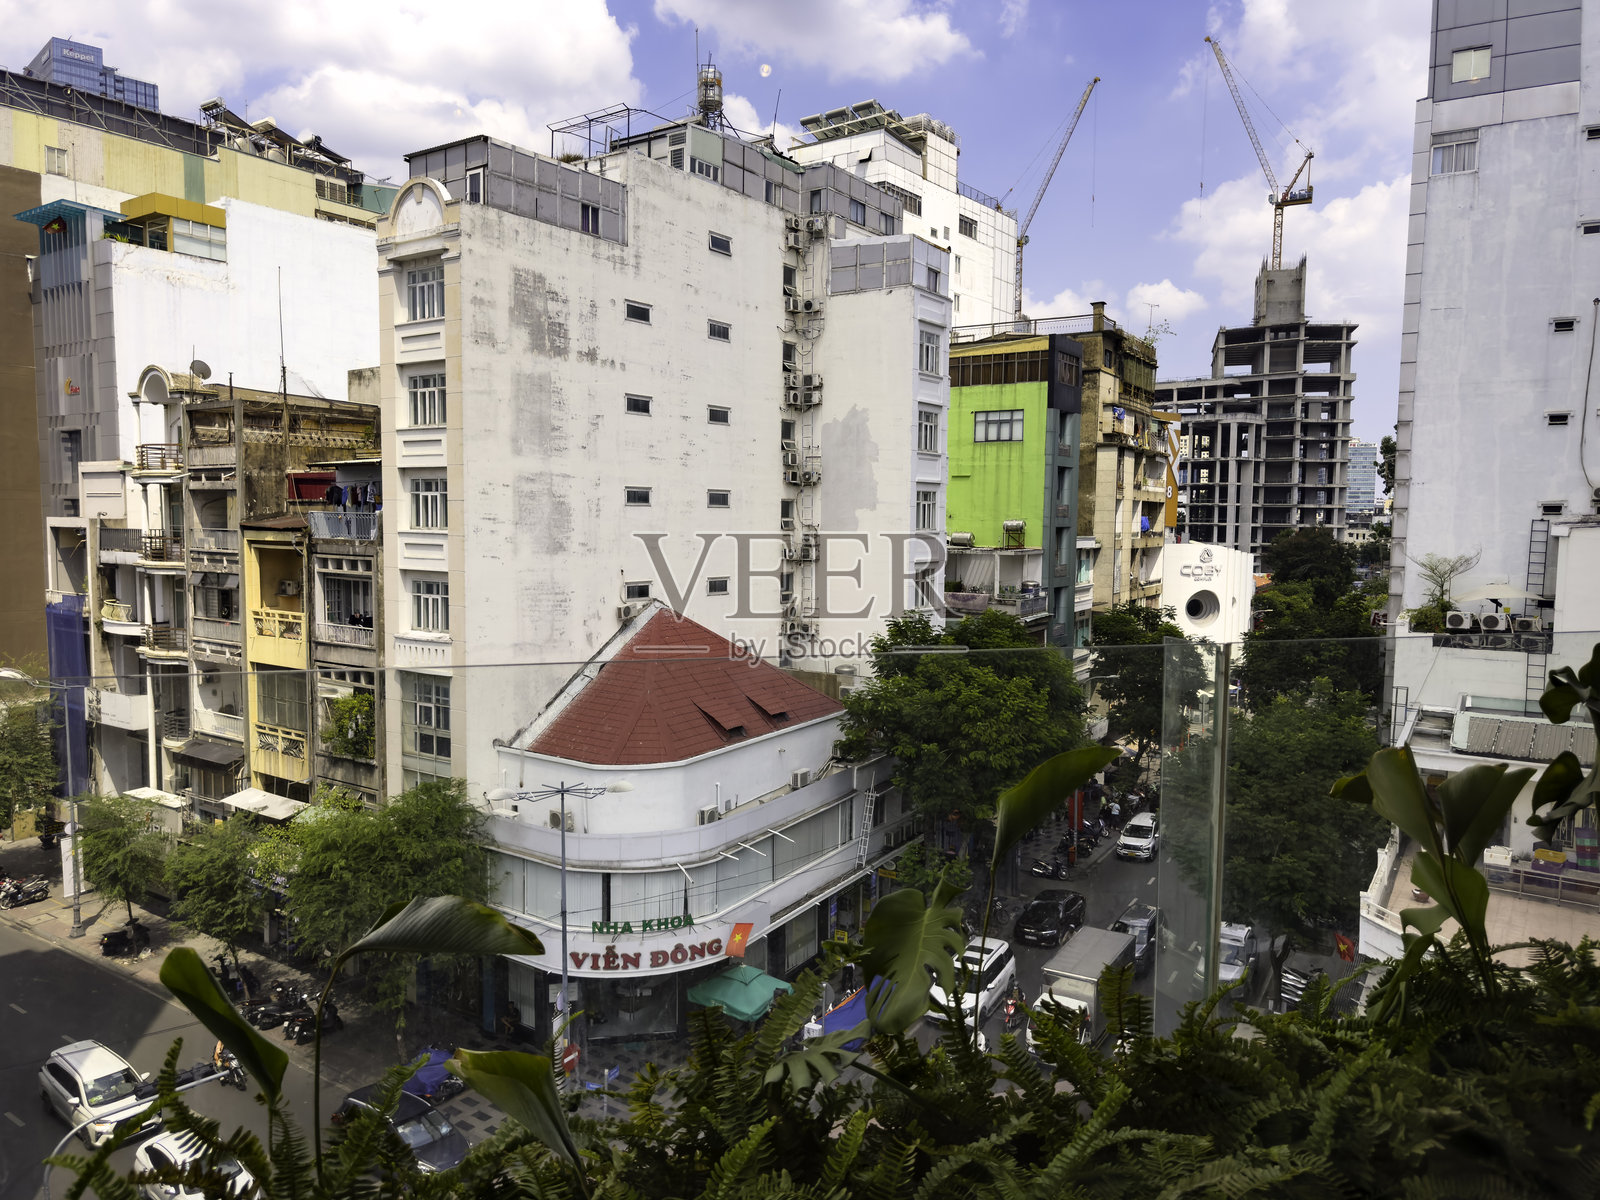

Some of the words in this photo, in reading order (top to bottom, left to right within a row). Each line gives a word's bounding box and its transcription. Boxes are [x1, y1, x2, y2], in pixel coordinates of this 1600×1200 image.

[63, 48, 94, 61] Keppel
[592, 921, 633, 934] NHA
[642, 914, 694, 932] KHOA
[650, 938, 723, 967] ĐÔNG
